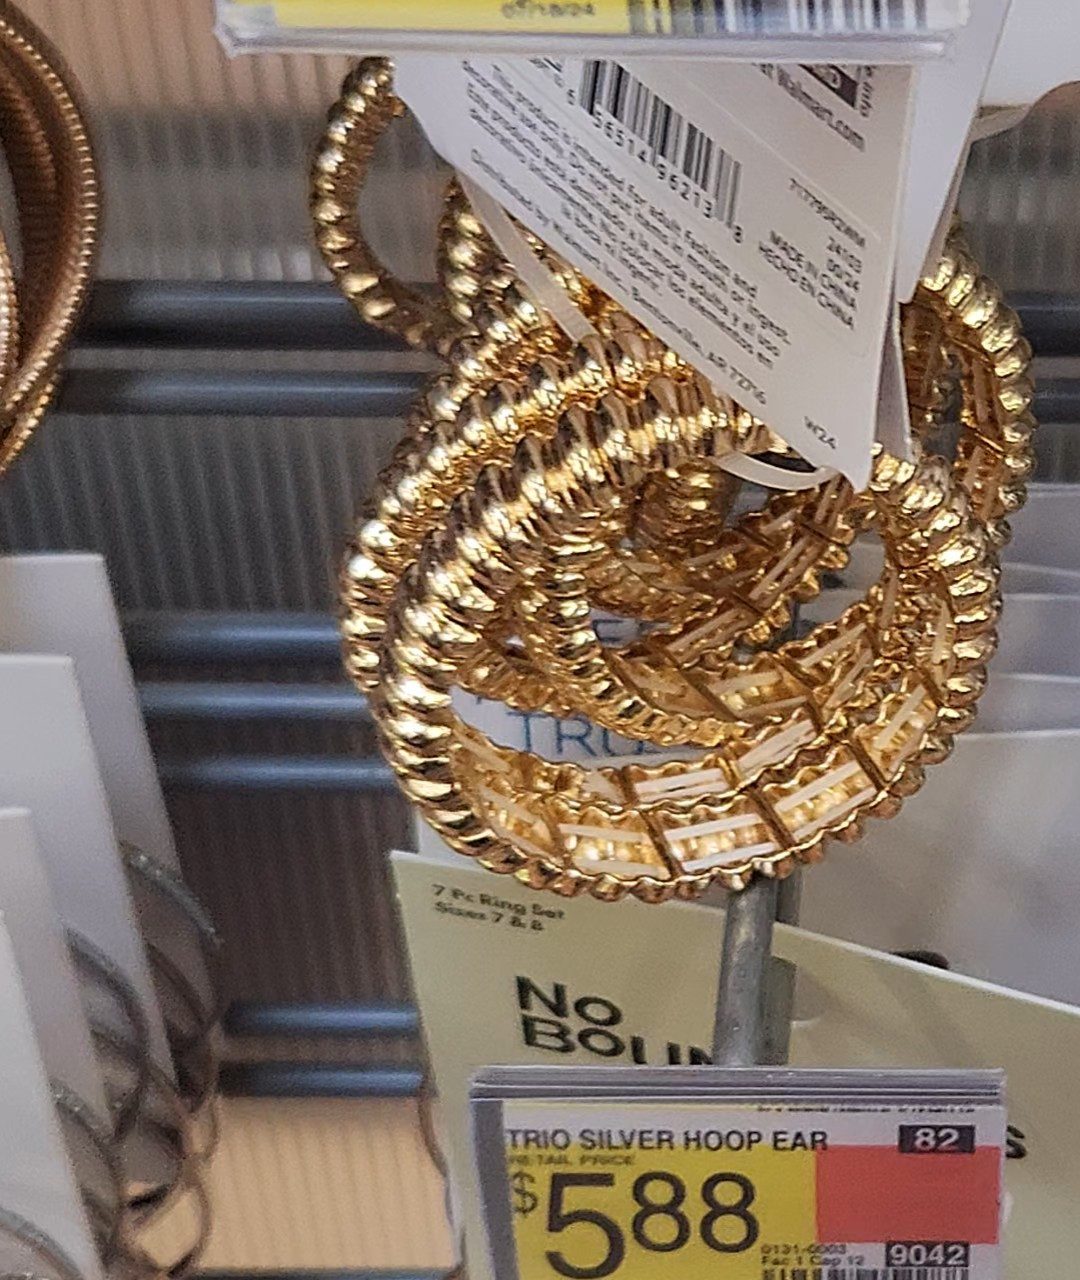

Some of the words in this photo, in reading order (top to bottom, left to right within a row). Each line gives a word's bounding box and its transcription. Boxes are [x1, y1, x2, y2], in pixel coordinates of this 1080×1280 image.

[655, 158, 713, 222] 96213
[732, 221, 742, 245] 8
[626, 181, 647, 211] for
[733, 269, 756, 300] and
[768, 228, 803, 269] MADE
[820, 270, 857, 312] CHINA
[799, 274, 816, 299] EN
[817, 289, 854, 331] CHINA
[432, 884, 445, 896] 7
[479, 893, 526, 915] Ring
[532, 903, 564, 919] Set
[434, 901, 486, 920] Sizes
[491, 911, 503, 923] 7
[507, 1129, 570, 1150] TRIO
[579, 1129, 674, 1151] SILVER
[684, 1130, 762, 1152] HOOP
[773, 1131, 828, 1151] EAR
[914, 1127, 960, 1151] 82
[580, 1154, 635, 1166] PRICE
[761, 1256, 790, 1266] Fac
[810, 1256, 841, 1268] Cap
[847, 1256, 864, 1266] 12
[890, 1244, 965, 1266] 9042
